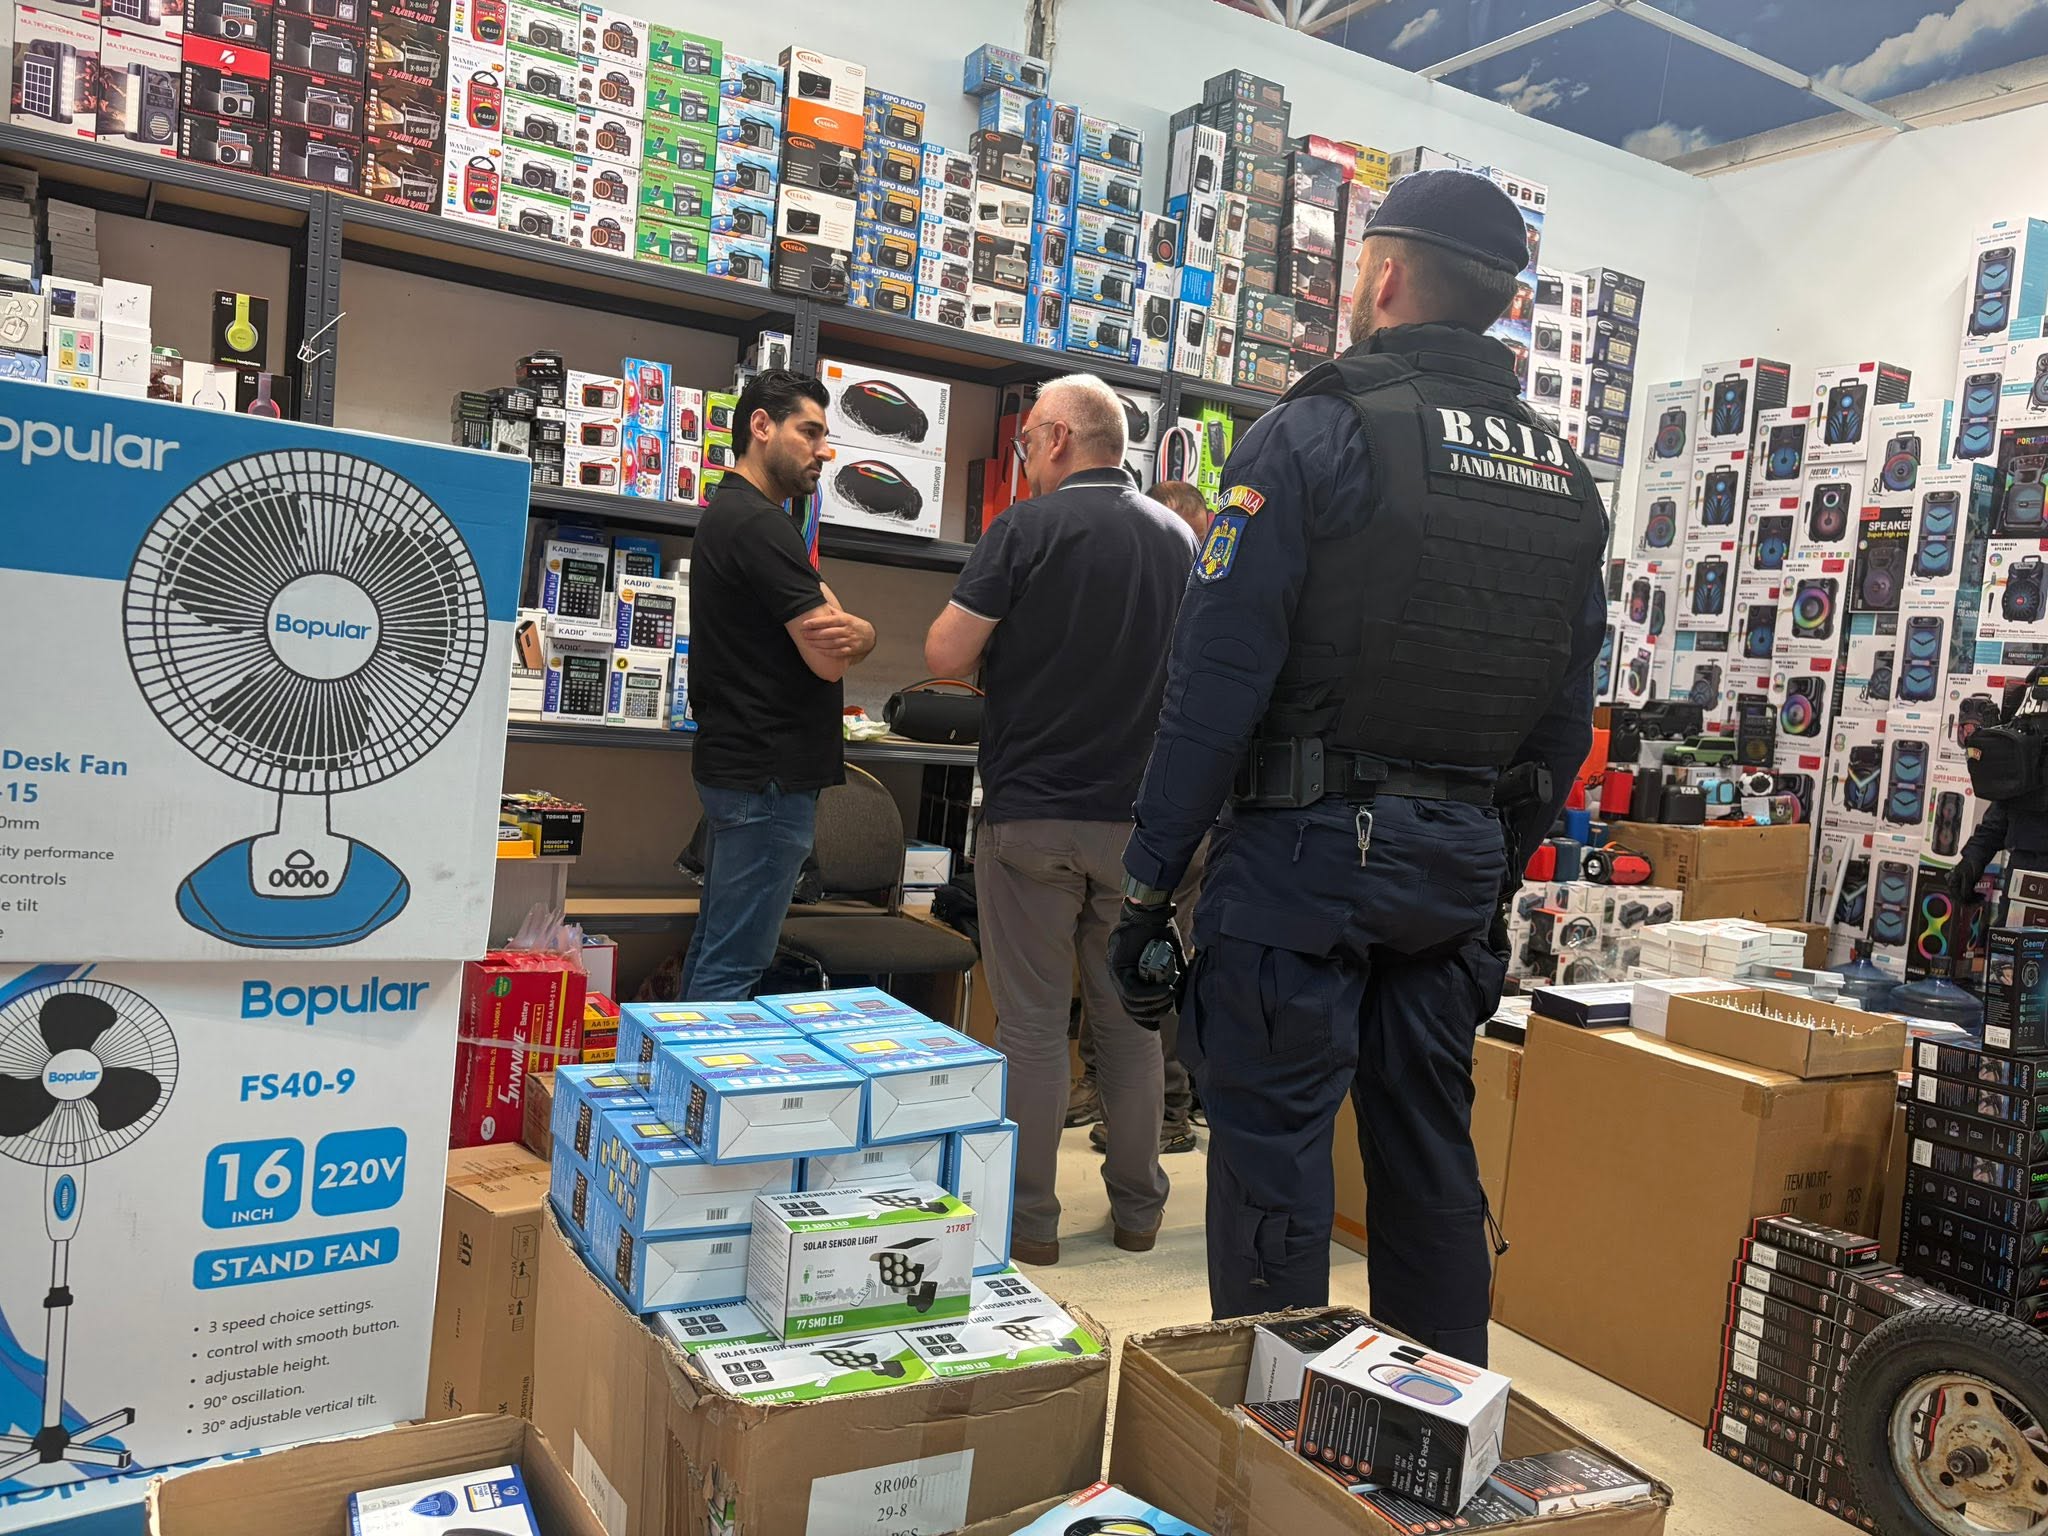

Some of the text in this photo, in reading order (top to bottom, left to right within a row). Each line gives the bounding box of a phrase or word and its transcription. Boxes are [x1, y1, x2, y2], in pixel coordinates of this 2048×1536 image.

[410, 64, 430, 73] X-BASS
[882, 93, 923, 111] KIPO RADIO
[477, 110, 495, 120] X-BASS
[410, 126, 430, 135] X-BASS
[879, 136, 920, 154] KIPO RADIO
[879, 179, 919, 196] KIPO RADIO
[875, 224, 916, 241] KIPO RADIO
[871, 267, 912, 283] KIPO RADIO
[1436, 408, 1569, 469] B.S.I.J.
[1450, 453, 1572, 495] JANDARMERIA
[552, 545, 578, 554] KADIO
[624, 578, 651, 588] KADIO
[275, 613, 372, 639] Bopular
[558, 628, 585, 637] KADIO
[553, 642, 579, 652] KADIO
[2, 750, 128, 776] Desk Fan
[0, 782, 39, 803] 15
[24, 847, 114, 860] performance
[0, 872, 67, 885] controls
[16, 898, 39, 912] tilt
[2023, 938, 2046, 950] Geemy
[241, 976, 430, 1026] Bopular
[48, 1070, 100, 1084] Bopular
[240, 1068, 355, 1102] FS40-9
[218, 1148, 292, 1202] 16
[318, 1156, 403, 1189] 220V
[771, 1188, 864, 1202] SOLAR SENSOR LIGHT
[232, 1207, 274, 1223] INCH
[945, 1223, 972, 1234] 2178T
[461, 1232, 473, 1267] UP
[803, 1235, 879, 1251] SOLAR SENSOR LIGHT
[211, 1238, 380, 1282] STAND FAN
[208, 1300, 374, 1333] 3 speed choice settings.
[796, 1314, 844, 1330] 77 SMD LED
[971, 1315, 995, 1325] LIGHT
[207, 1319, 400, 1359] control with smooth button.
[714, 1344, 787, 1361] SOLAR SENSOR
[205, 1355, 330, 1386] adjustable height.
[203, 1385, 305, 1410] 90° oscillation.
[201, 1393, 377, 1435] 30° adjustable vertical tilt.
[874, 1474, 918, 1496] 8R006
[877, 1503, 907, 1522] 29-8
